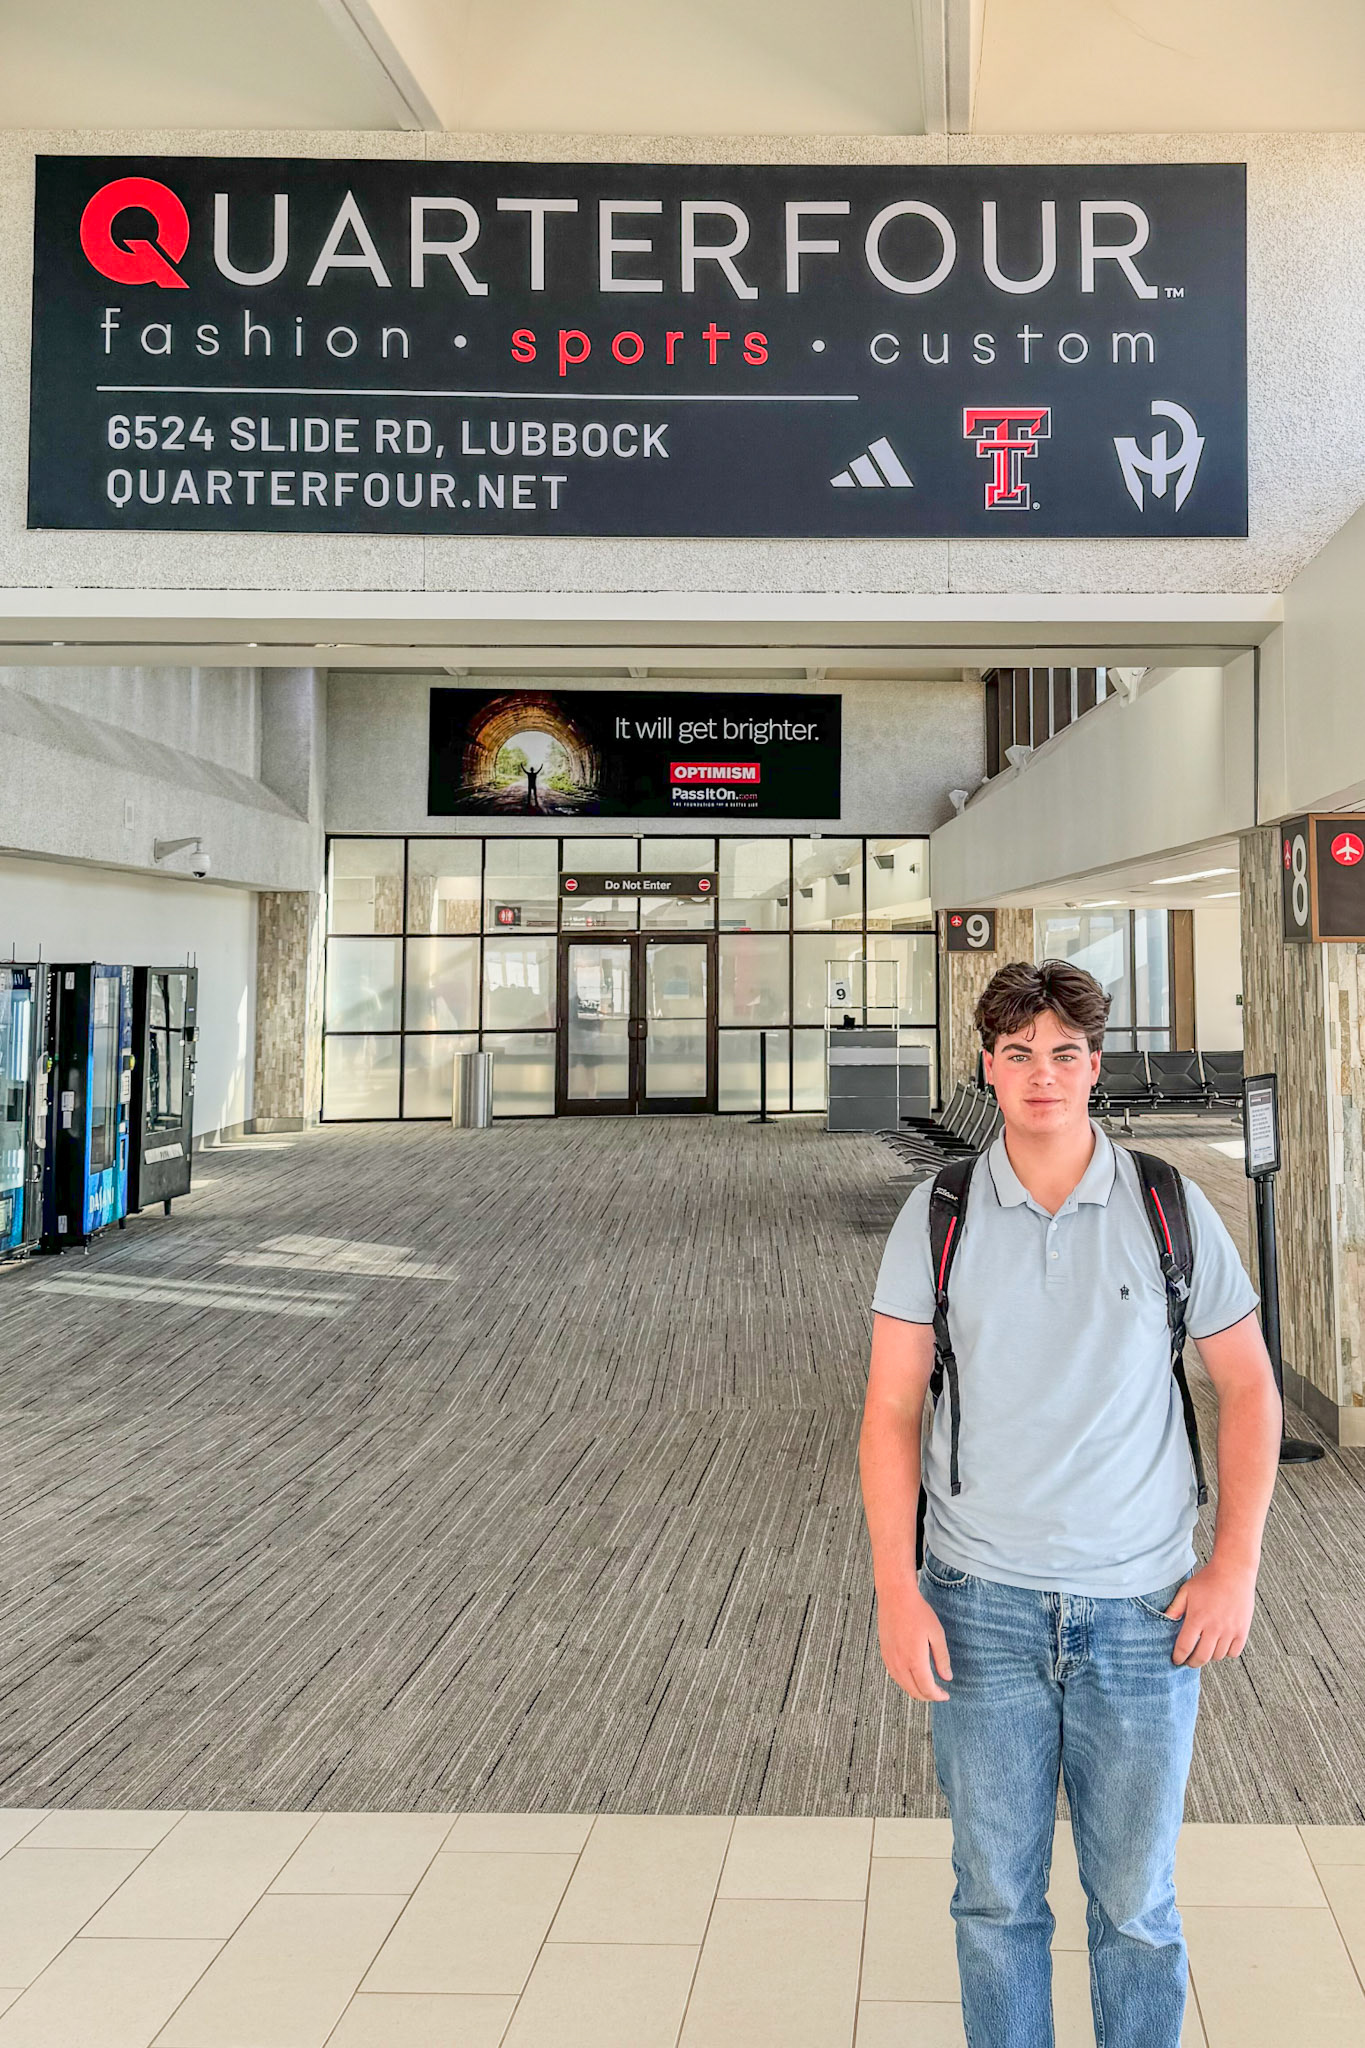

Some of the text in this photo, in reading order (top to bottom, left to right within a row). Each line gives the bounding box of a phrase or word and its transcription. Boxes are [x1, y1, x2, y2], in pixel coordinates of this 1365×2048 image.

[80, 177, 1158, 300] QUARTERFOUR
[101, 308, 1158, 377] fashion sports custom
[108, 415, 670, 459] 6524 SLIDE RD, LUBBOCK
[106, 468, 568, 510] QUARTERFOUR.NET
[615, 716, 820, 745] It will get brighter.
[674, 766, 756, 779] OPTIMISM
[604, 880, 672, 890] Do Not Enter
[1291, 833, 1309, 927] 8
[965, 914, 990, 948] 9
[836, 988, 847, 1001] 9
